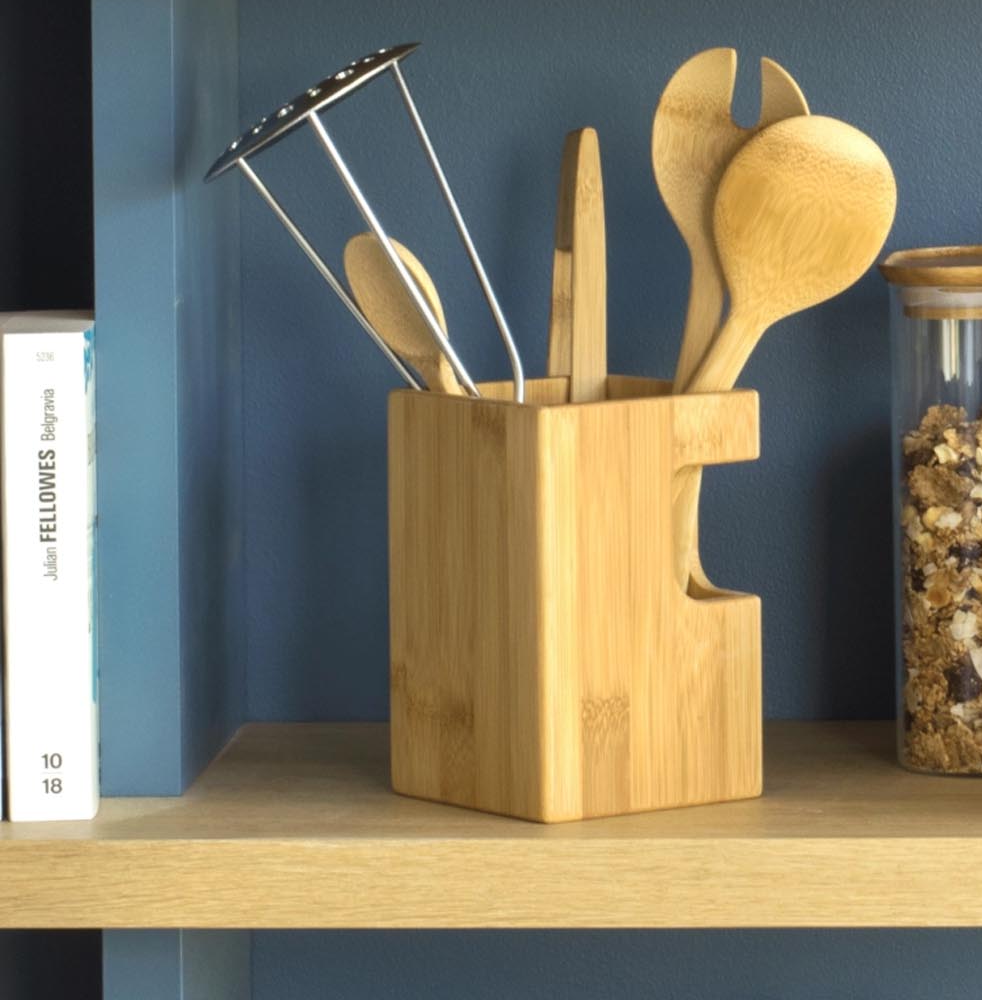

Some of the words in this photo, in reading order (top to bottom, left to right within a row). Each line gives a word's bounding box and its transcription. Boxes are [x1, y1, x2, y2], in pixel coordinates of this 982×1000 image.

[40, 388, 58, 442] Belgravia
[38, 449, 57, 542] FELLOWES
[43, 547, 58, 582] Julian
[41, 752, 63, 769] 10
[42, 777, 63, 794] 18
